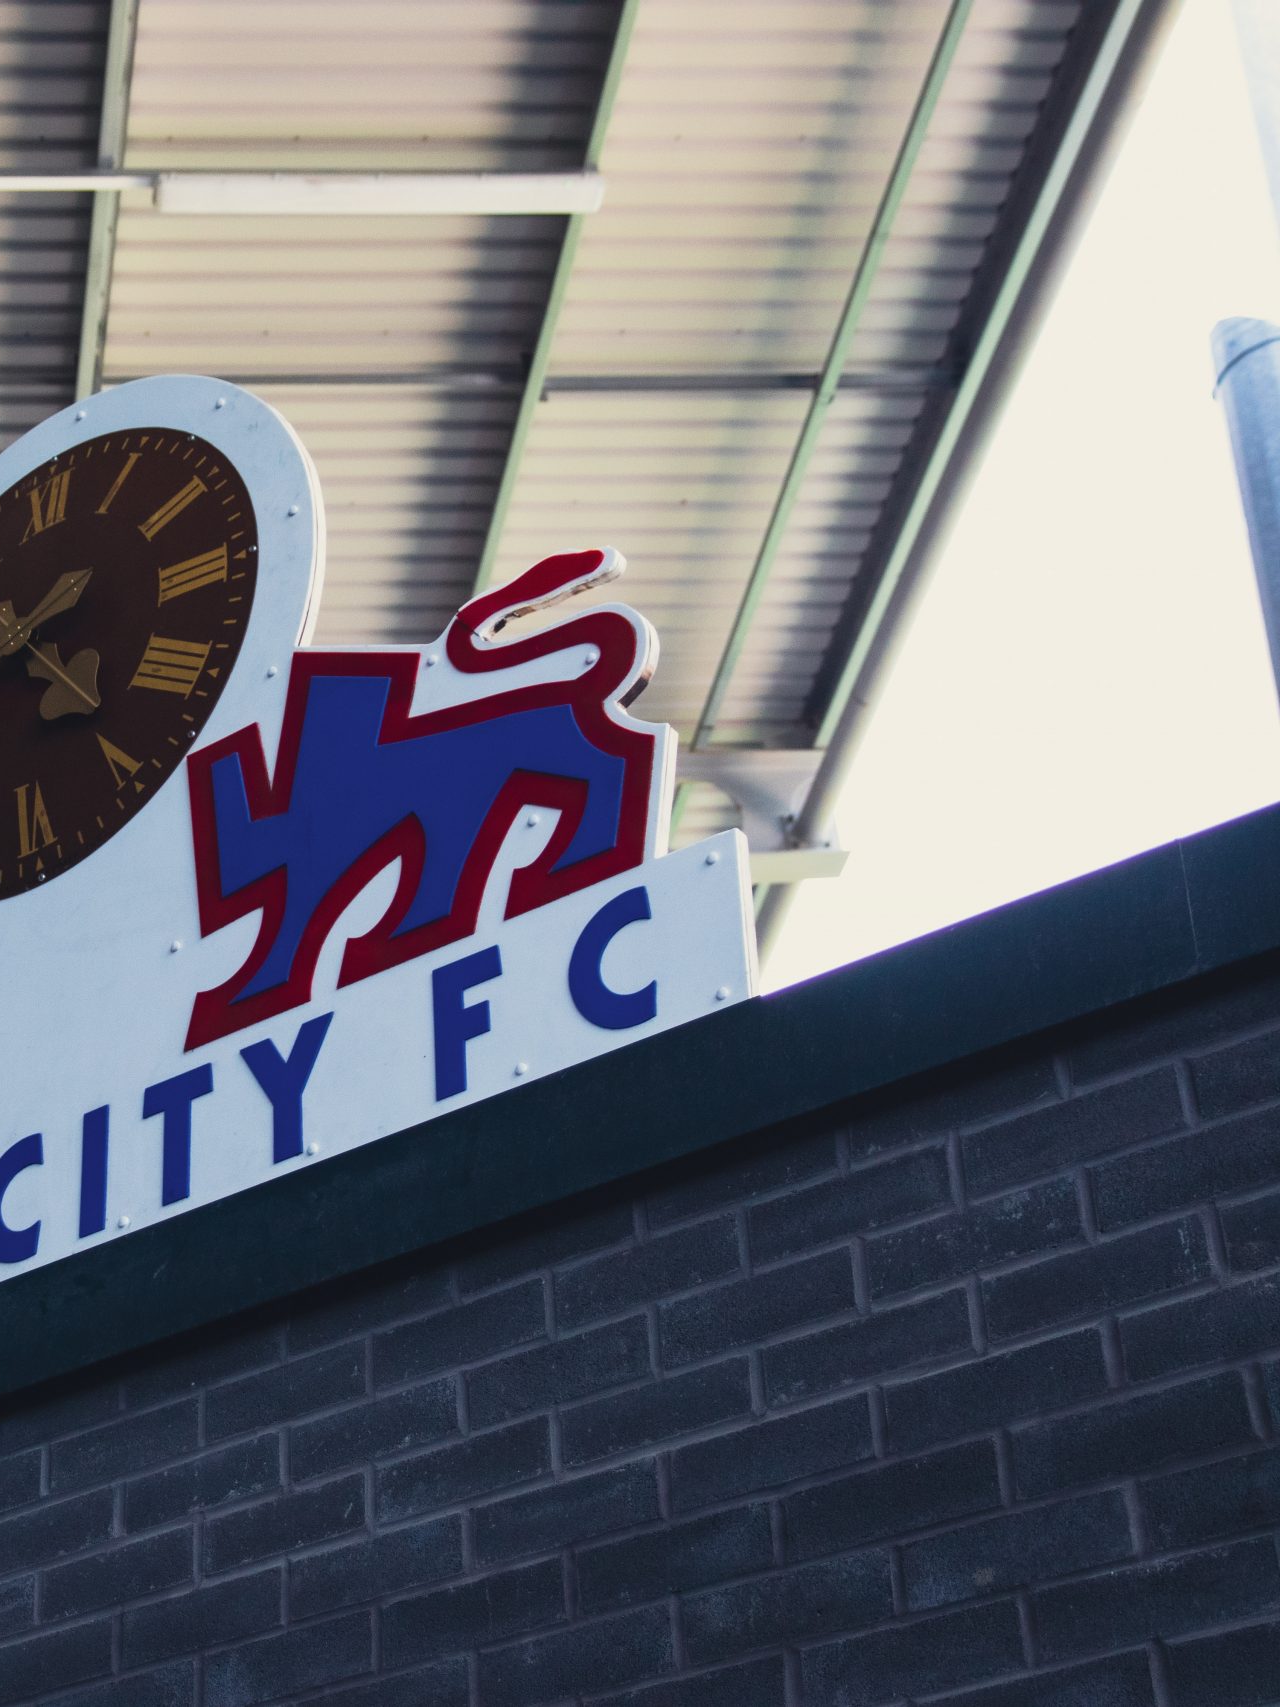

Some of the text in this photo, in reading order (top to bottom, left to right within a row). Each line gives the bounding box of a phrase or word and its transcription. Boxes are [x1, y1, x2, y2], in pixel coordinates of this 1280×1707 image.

[19, 467, 75, 545] XII
[94, 452, 143, 514] I
[137, 474, 208, 542] II
[157, 541, 228, 607] III
[126, 632, 213, 700] IIII
[95, 732, 144, 791] V
[14, 779, 59, 858] VI
